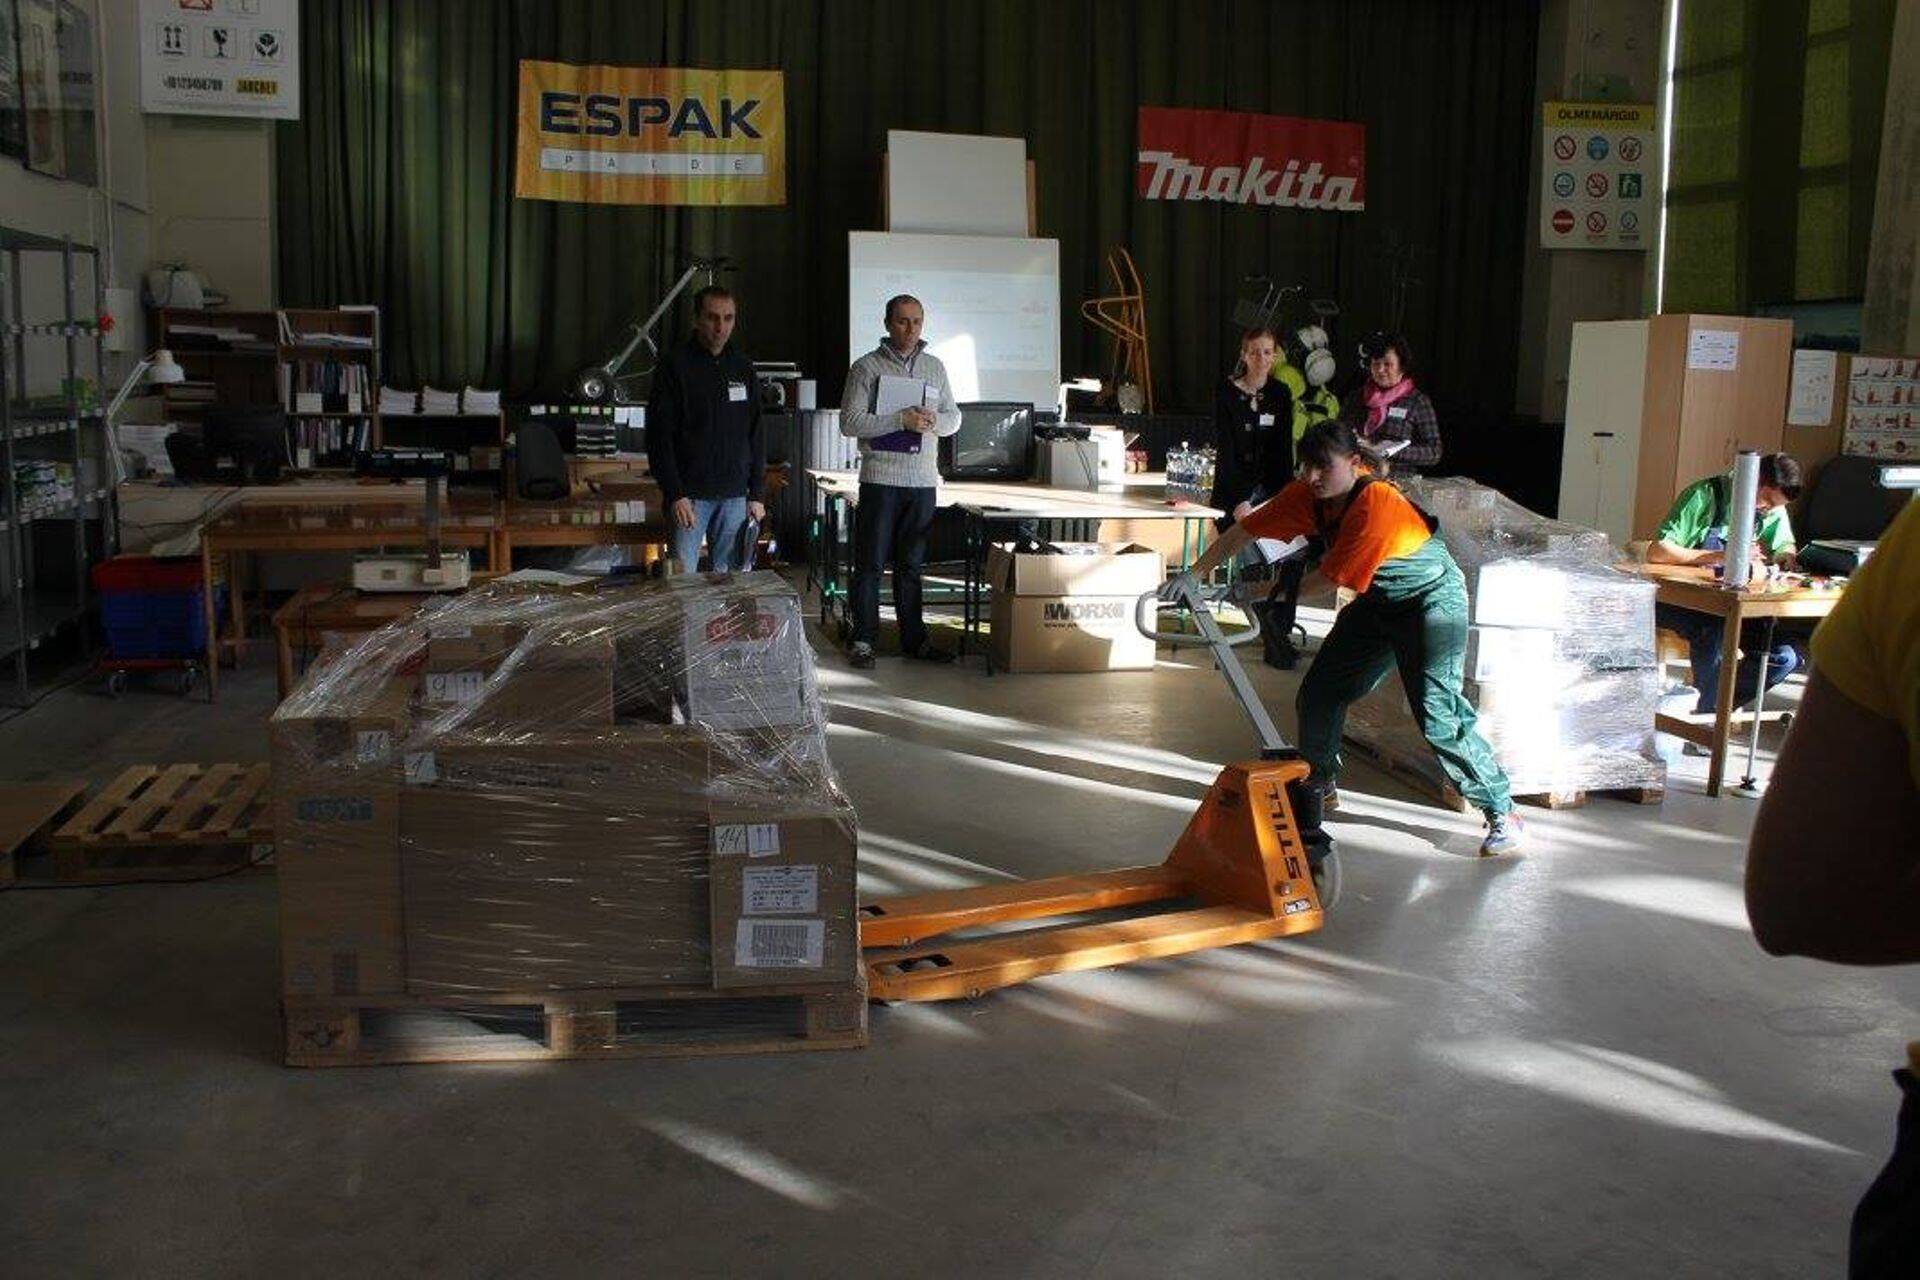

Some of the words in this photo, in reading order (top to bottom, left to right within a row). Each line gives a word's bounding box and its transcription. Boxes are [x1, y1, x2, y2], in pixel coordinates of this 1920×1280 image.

[541, 91, 762, 139] ESPAK
[564, 153, 743, 171] PAIDE
[1138, 150, 1365, 212] Makita
[1268, 782, 1302, 879] STILL
